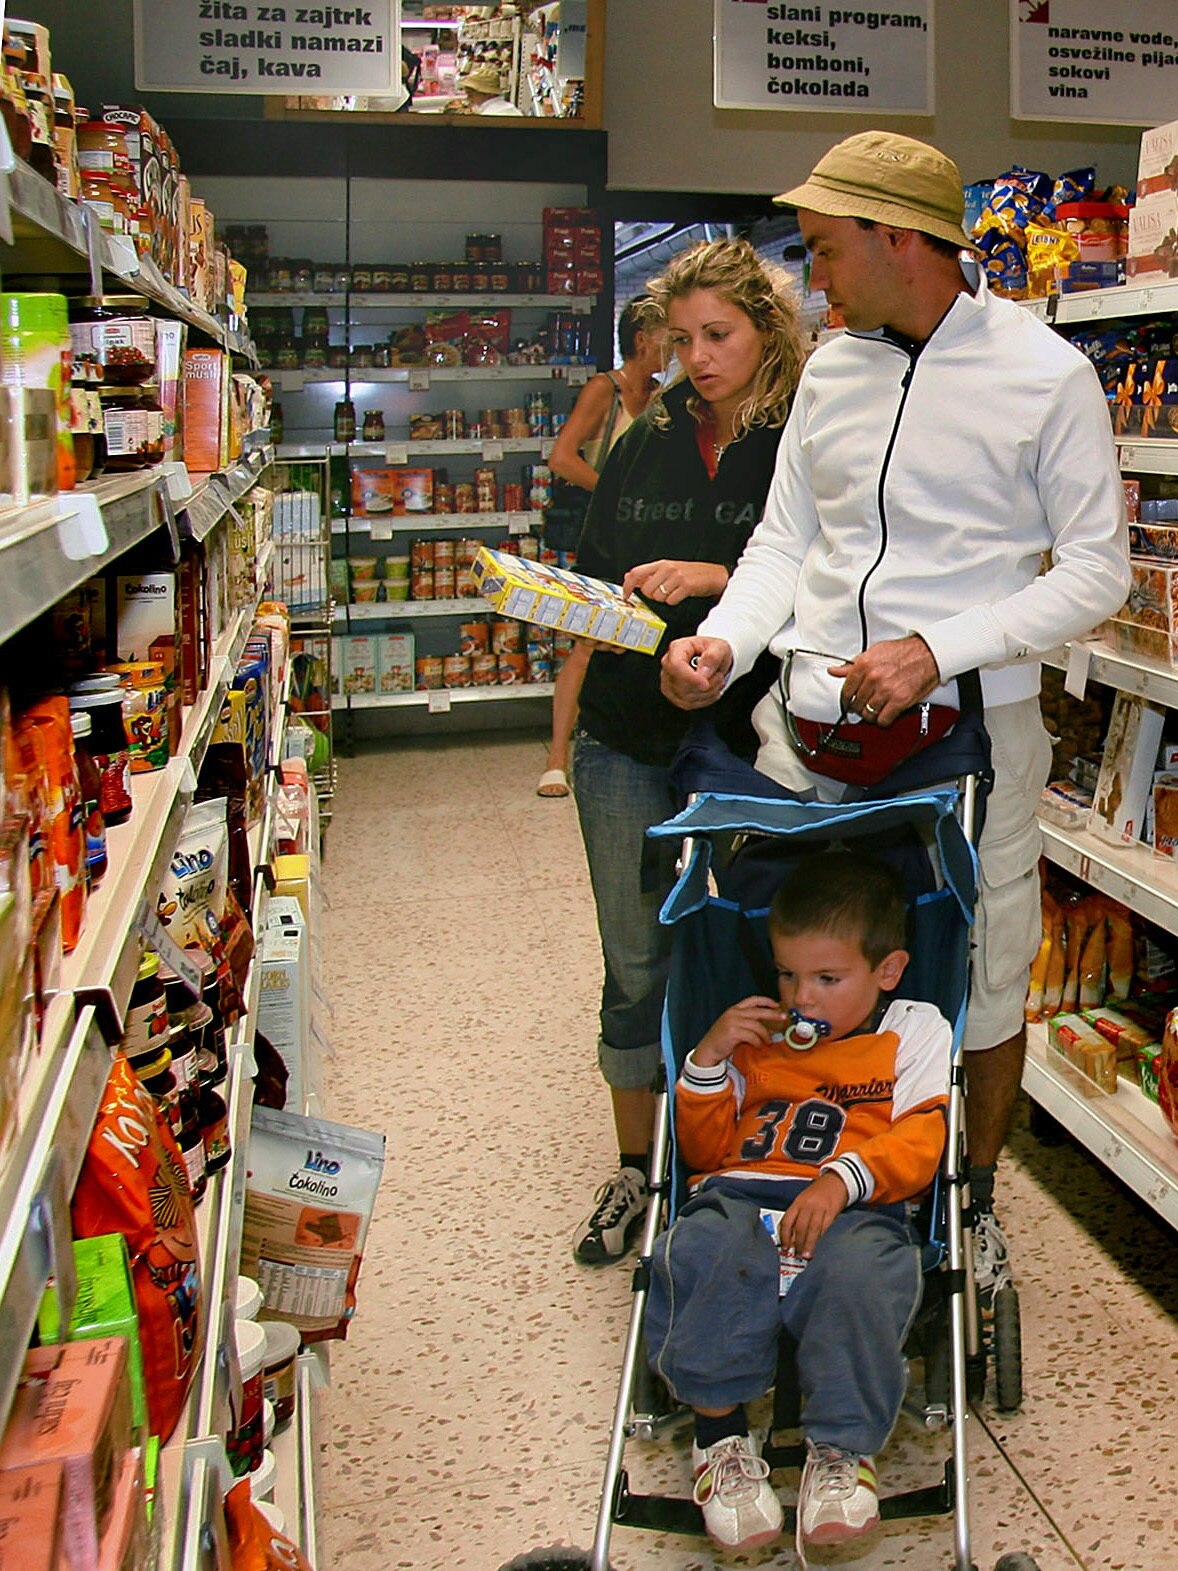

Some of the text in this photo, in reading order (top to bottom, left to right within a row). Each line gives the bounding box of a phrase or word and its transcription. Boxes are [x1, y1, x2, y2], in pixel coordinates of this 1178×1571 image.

[198, 0, 372, 28] žita za zajtrk
[767, 4, 928, 32] slani program,
[199, 29, 383, 53] sladki namazi
[767, 28, 836, 50] keksi,
[1048, 27, 1178, 49] naravne vode,
[767, 53, 870, 76] bomboni,
[1048, 46, 1135, 62] osvežilne
[200, 55, 321, 80] čaj, kava
[1049, 65, 1110, 80] sokovi
[767, 77, 869, 98] čokolada
[1049, 84, 1088, 98] vina
[186, 361, 219, 372] Sport
[616, 497, 693, 522] Street
[740, 1098, 847, 1164] 38
[305, 1150, 341, 1175] Lino
